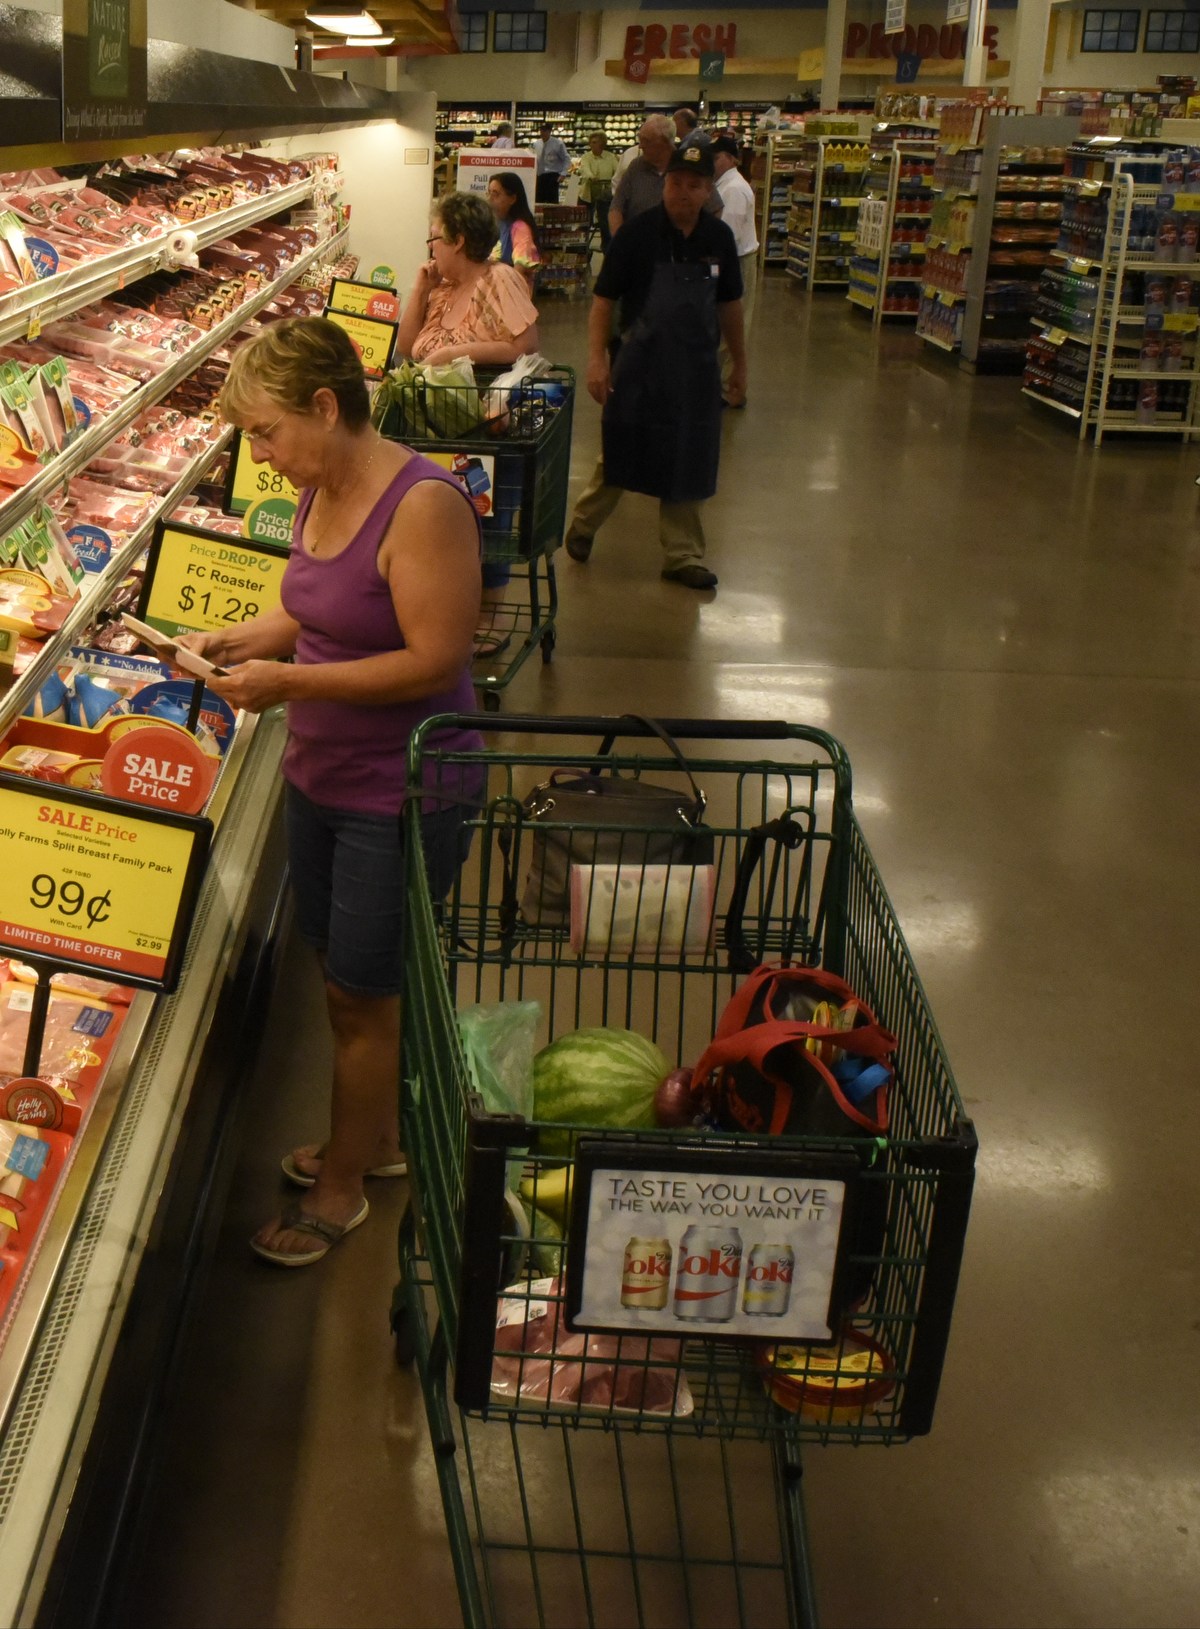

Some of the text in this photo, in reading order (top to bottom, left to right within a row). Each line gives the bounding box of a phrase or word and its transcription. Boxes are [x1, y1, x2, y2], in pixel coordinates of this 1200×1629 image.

[93, 2, 126, 33] NATURE
[625, 23, 737, 60] FRESH
[470, 157, 523, 166] COMING SOON
[474, 174, 488, 182] Full
[373, 276, 392, 285] DROP
[351, 286, 364, 294] SALE
[372, 301, 394, 313] SALE
[373, 309, 391, 318] Price
[345, 319, 362, 328] SALE
[258, 510, 290, 527] Price
[189, 544, 258, 568] Price DROP
[187, 563, 266, 593] FC Roaster
[178, 585, 259, 623] $1.28
[135, 664, 162, 676] Added
[123, 753, 194, 787] SALE
[127, 776, 180, 803] Price
[37, 805, 138, 843] SALE Price
[56, 829, 111, 847] Selected Varieties
[18, 831, 49, 846] Farms
[52, 839, 75, 852] Split
[77, 845, 110, 861] Breast
[112, 853, 146, 870] Family
[148, 861, 173, 874] Pack
[29, 873, 112, 930] 99¢
[49, 918, 82, 931] With Card
[4, 925, 123, 962] LIMITED TIME OFFER
[135, 937, 162, 951] $2.99
[17, 1098, 42, 1114] Holly
[16, 1109, 47, 1124] Farms
[609, 1178, 828, 1206] TASTE YOU LOVE
[608, 1198, 824, 1222] THE WAY YOU WANT IT
